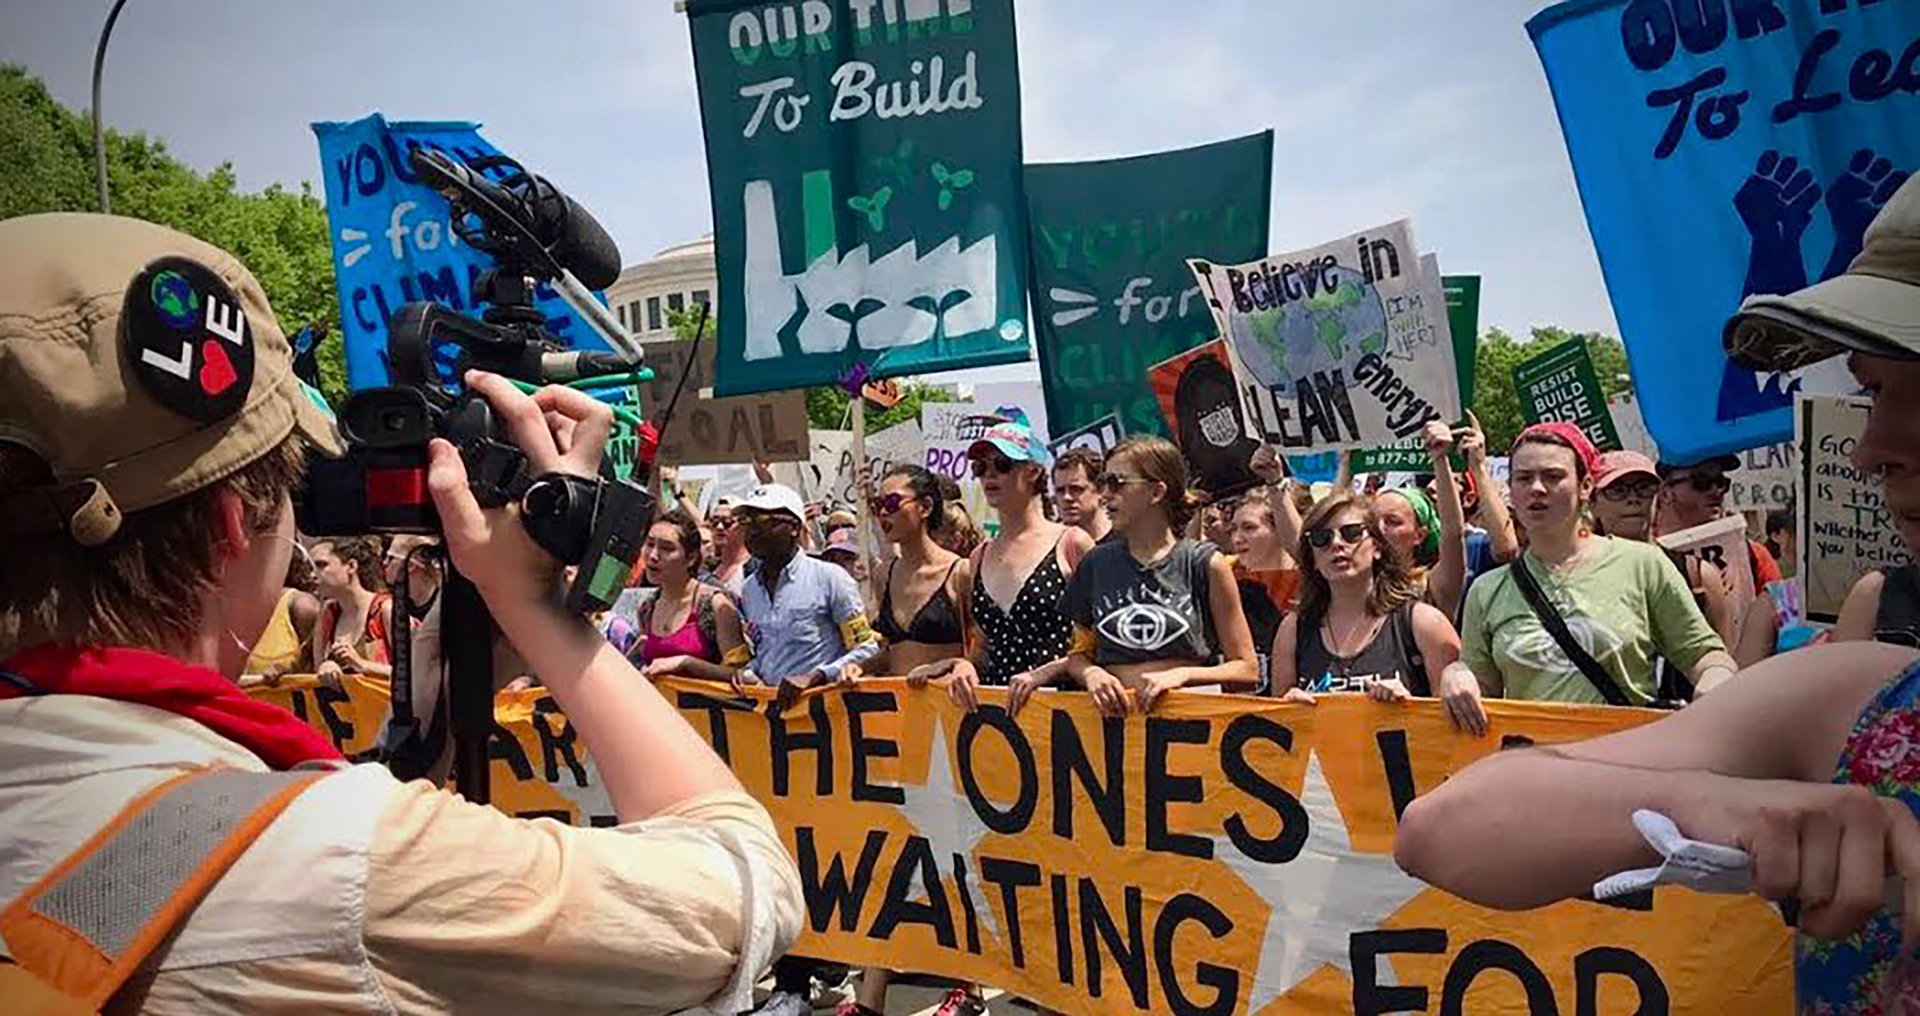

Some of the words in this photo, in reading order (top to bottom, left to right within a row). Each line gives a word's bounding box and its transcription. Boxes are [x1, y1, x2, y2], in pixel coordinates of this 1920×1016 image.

[729, 0, 832, 65] OUR
[739, 76, 811, 137] To
[829, 51, 984, 121] Build
[1646, 66, 1749, 159] To
[1113, 277, 1200, 325] for
[1226, 254, 1339, 313] Believe
[1358, 237, 1400, 285] in
[1352, 351, 1441, 439] energy
[1530, 366, 1577, 398] RESIST
[1534, 381, 1584, 413] BUILD
[926, 447, 968, 482] PRO
[1855, 542, 1916, 565] believ
[677, 690, 906, 806] THE
[956, 704, 1310, 864] ONES
[795, 826, 1240, 1016] WAITING
